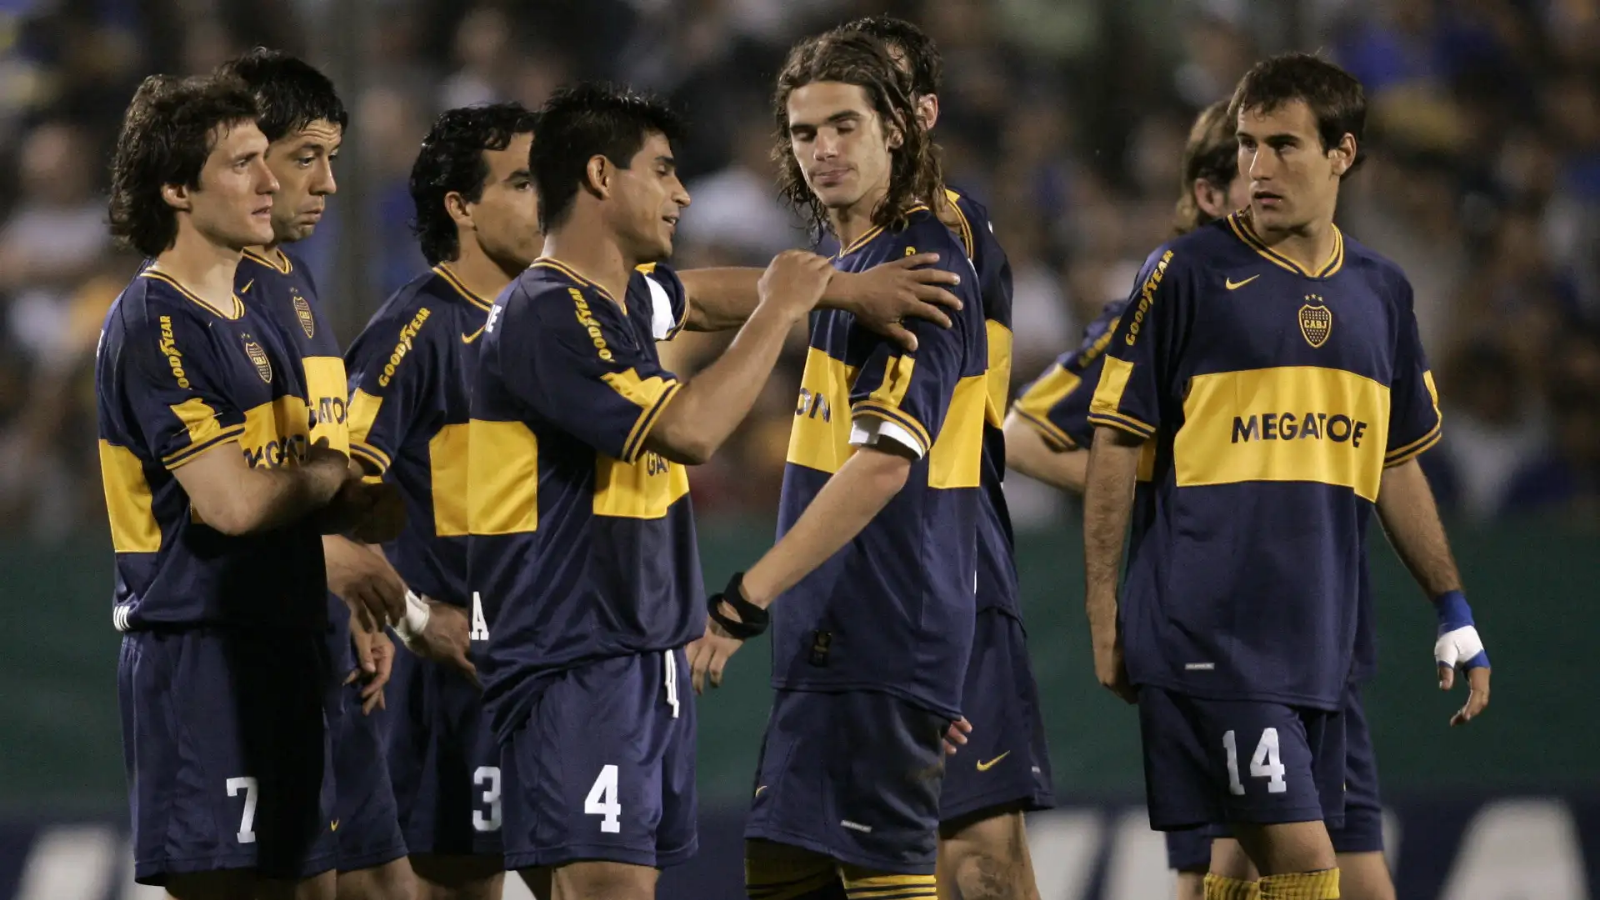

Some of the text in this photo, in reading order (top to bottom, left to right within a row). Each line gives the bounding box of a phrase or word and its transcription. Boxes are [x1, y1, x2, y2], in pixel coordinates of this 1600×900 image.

[1125, 249, 1174, 346] GOODYEAR
[1304, 319, 1328, 329] CABJ
[159, 315, 192, 390] OODYEAR
[378, 307, 431, 387] GOODYEAR
[1231, 412, 1367, 448] MEGATOE
[1222, 727, 1287, 795] 14
[226, 776, 258, 843] 7
[472, 766, 502, 831] 3
[584, 764, 622, 833] 4
